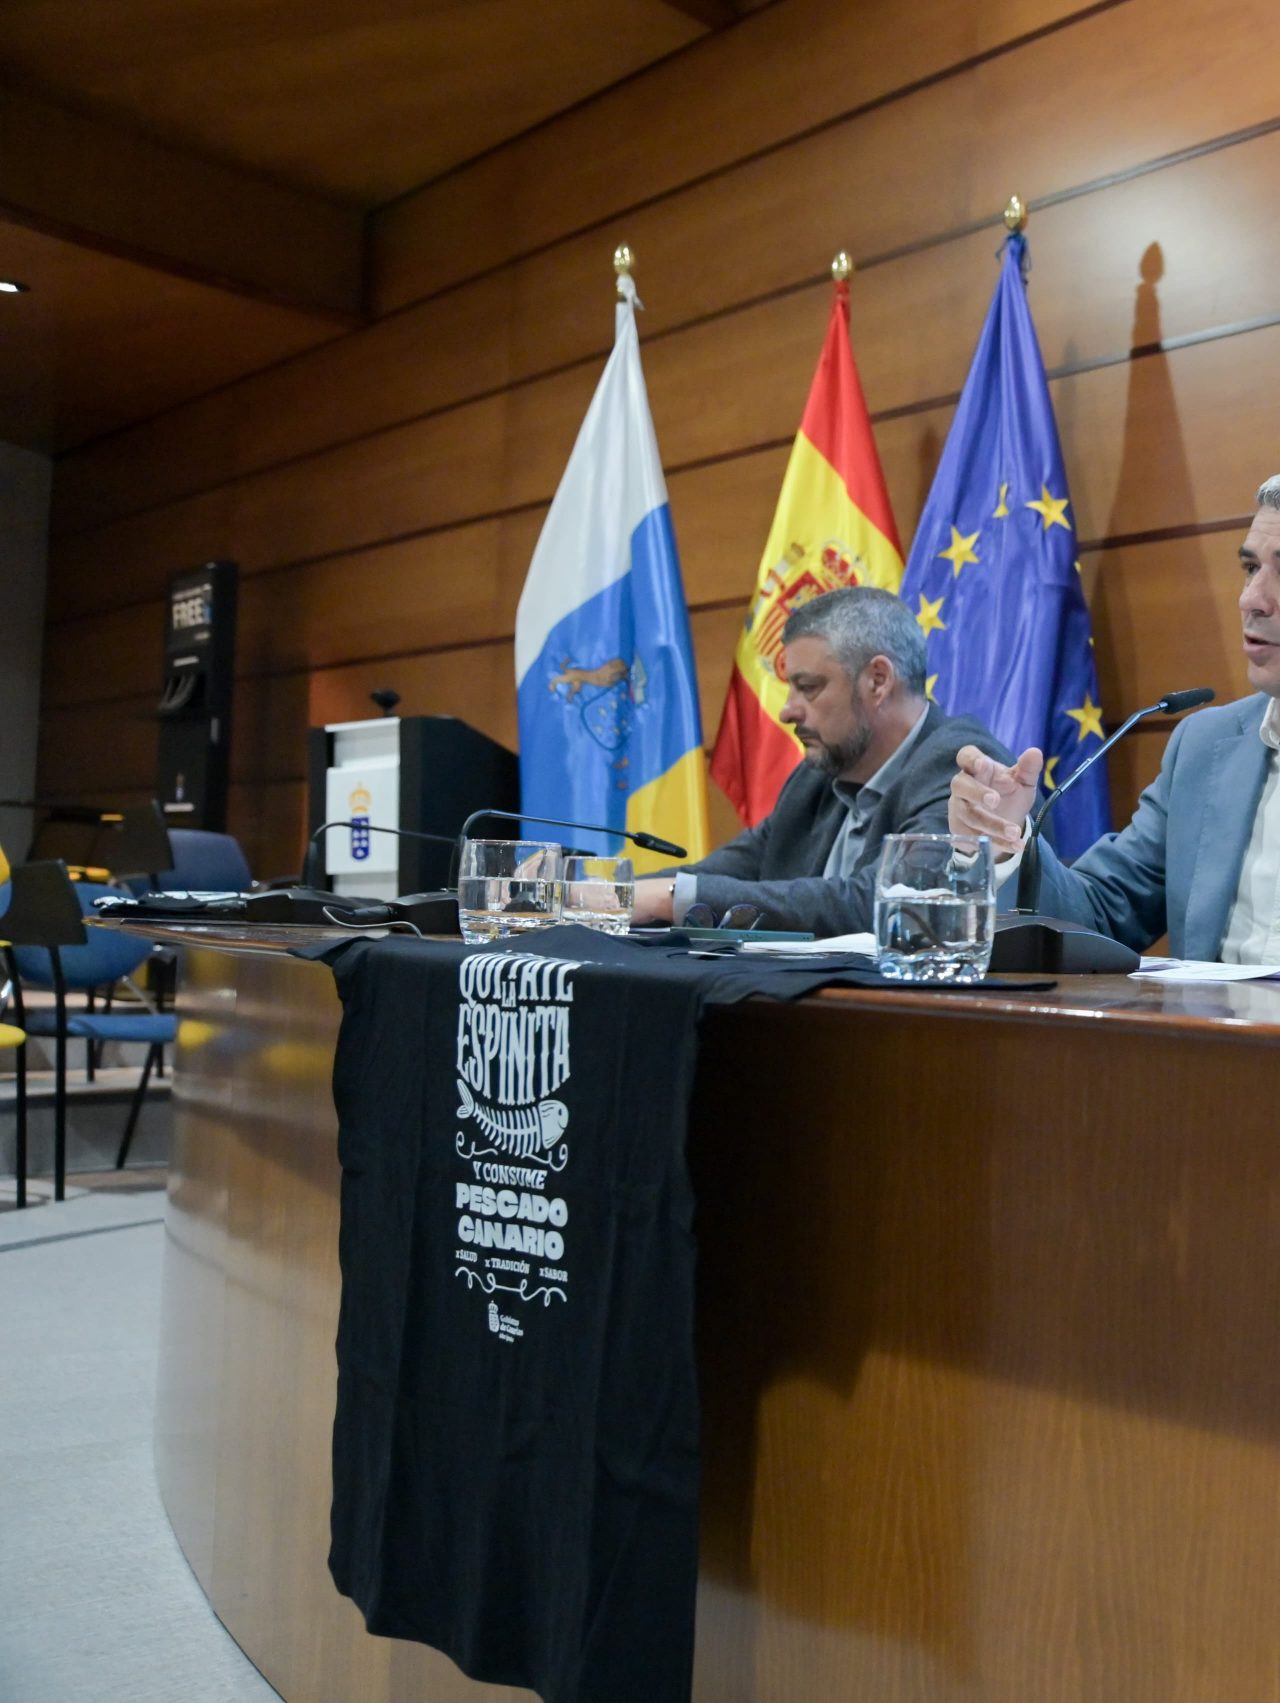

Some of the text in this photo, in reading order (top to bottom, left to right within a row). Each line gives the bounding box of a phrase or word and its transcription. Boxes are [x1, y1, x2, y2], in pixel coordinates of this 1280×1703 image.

[501, 981, 516, 1007] LA
[457, 1003, 571, 1105] ESPINITA
[473, 1161, 547, 1190] Y CONSUME
[456, 1182, 568, 1227] PESCADO
[458, 1215, 564, 1260] CANARIO
